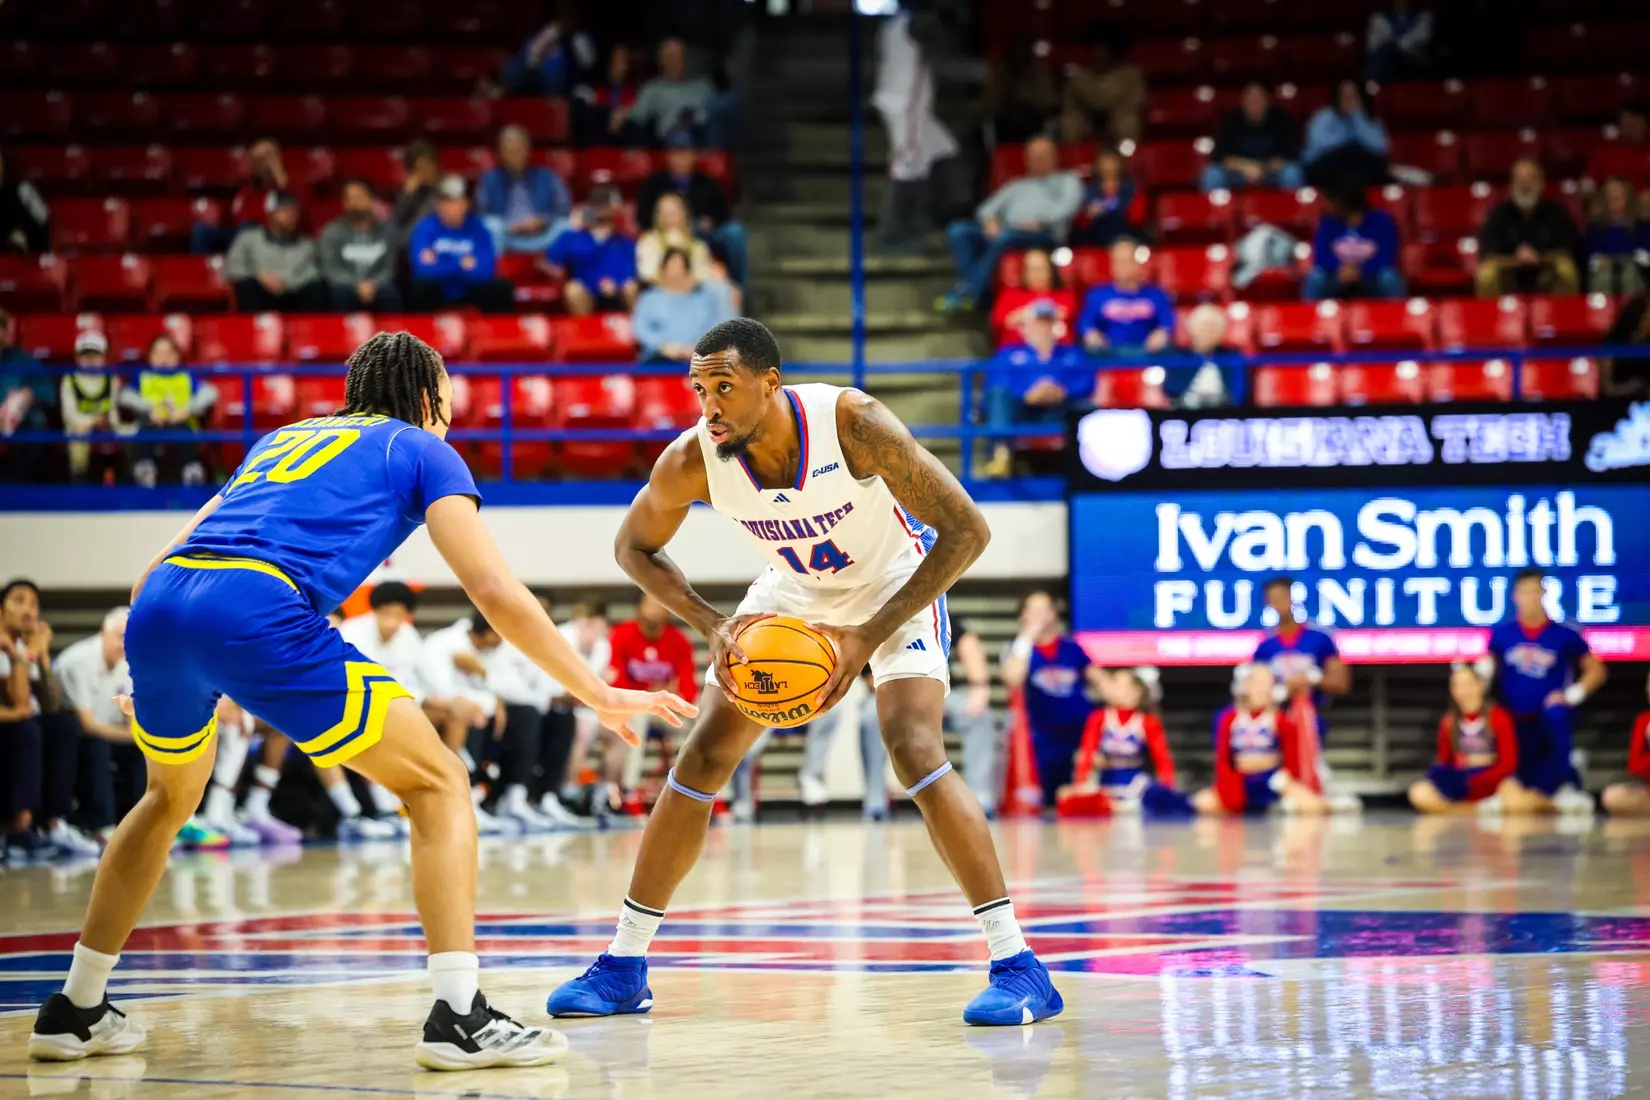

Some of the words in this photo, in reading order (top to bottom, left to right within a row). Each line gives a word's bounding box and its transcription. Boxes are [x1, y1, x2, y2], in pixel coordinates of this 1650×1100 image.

[226, 428, 361, 495] 20
[812, 462, 839, 478] C-USA
[734, 517, 819, 541] OUISIANA
[1155, 502, 1347, 572] Ivan
[1352, 490, 1617, 570] Smith
[776, 538, 855, 575] 14
[738, 703, 812, 723] Wilson
